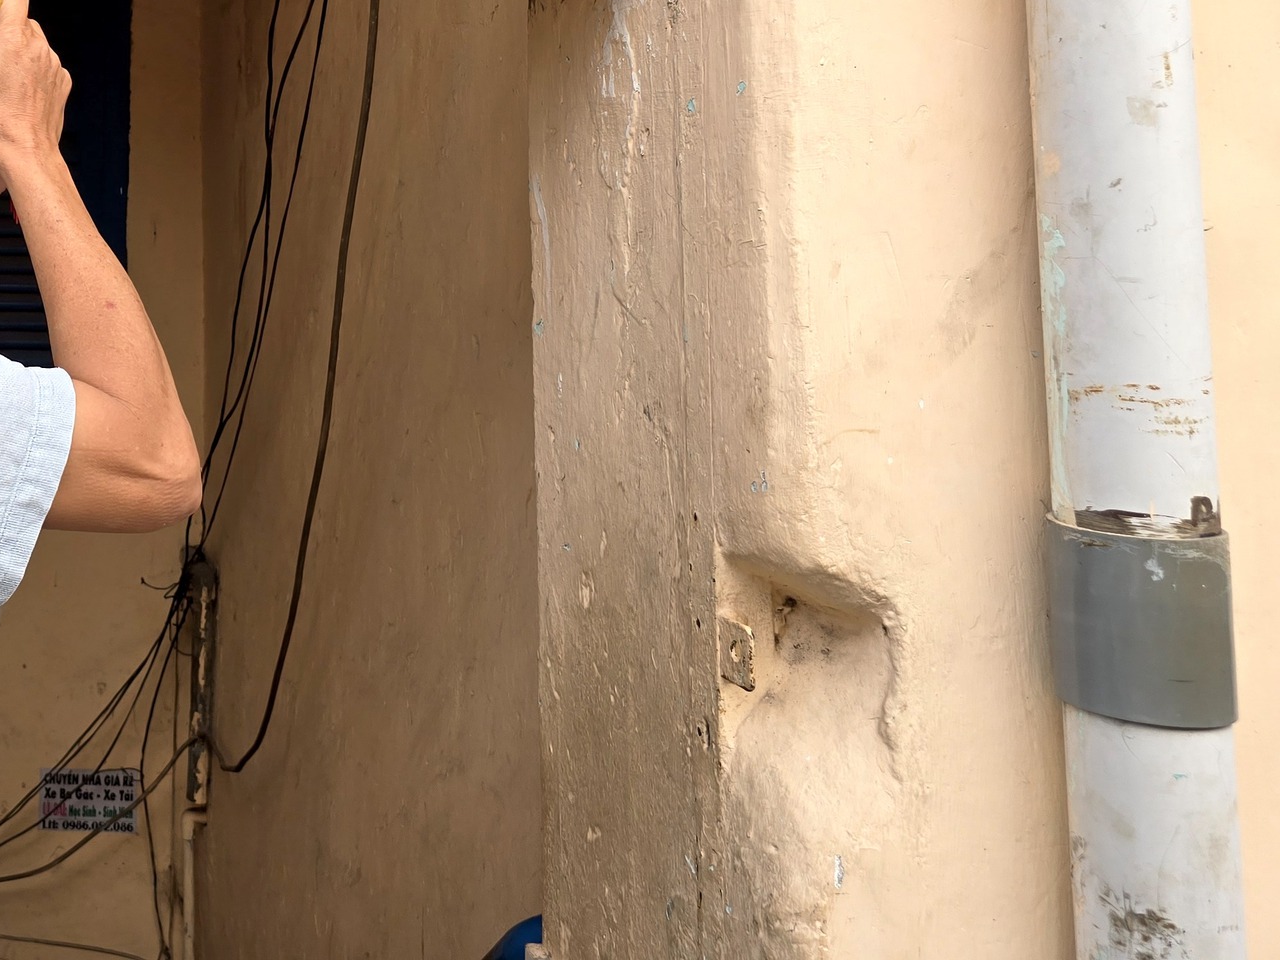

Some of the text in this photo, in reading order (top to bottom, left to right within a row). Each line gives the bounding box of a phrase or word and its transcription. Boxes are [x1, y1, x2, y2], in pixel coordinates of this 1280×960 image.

[44, 787, 56, 799] Xe
[103, 789, 116, 801] Xe
[119, 789, 133, 801] Tải
